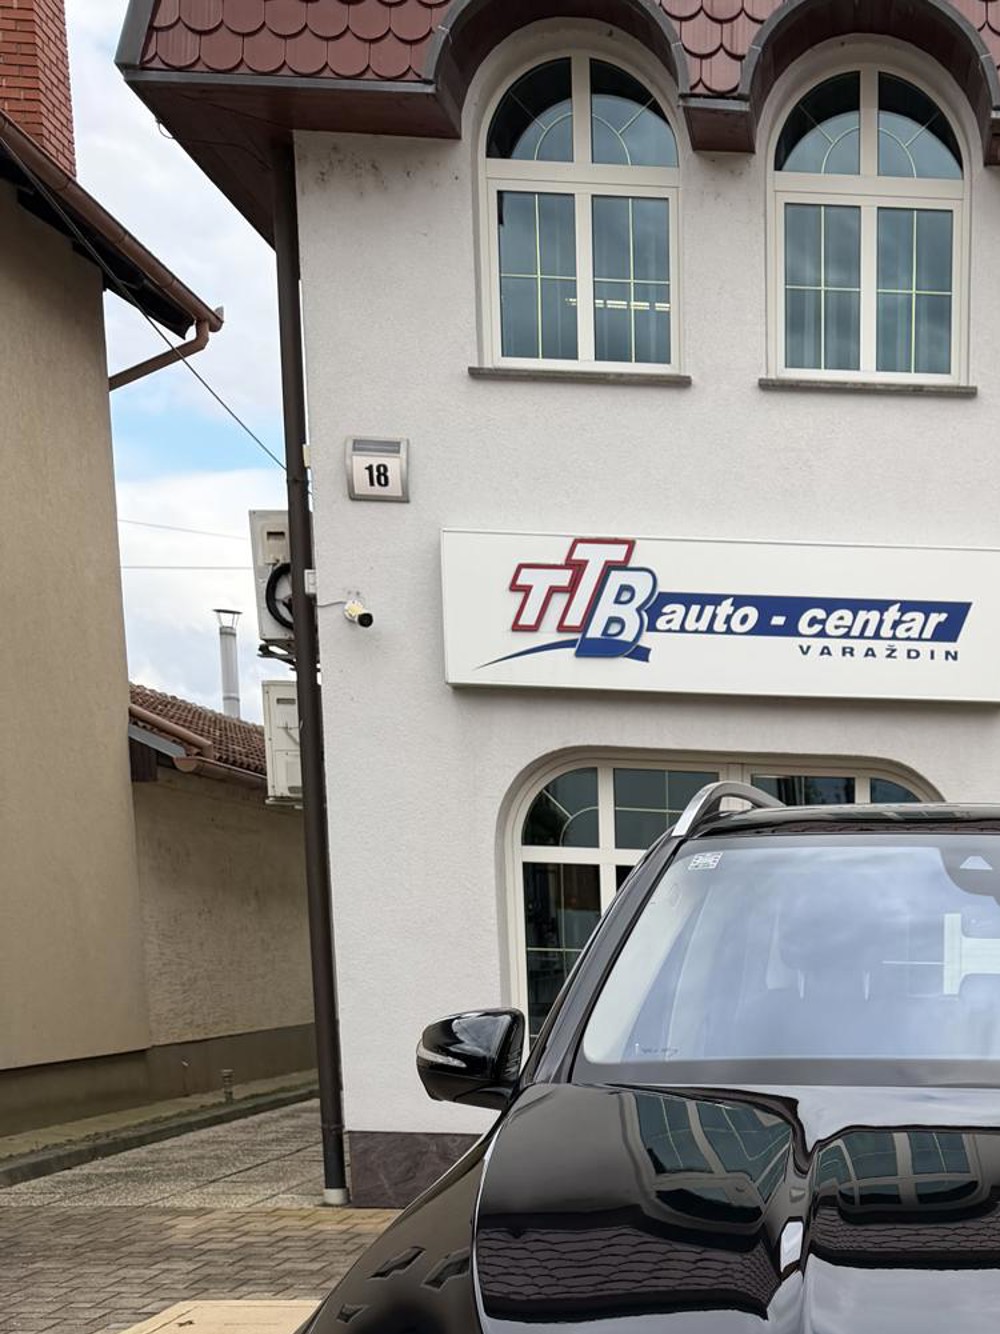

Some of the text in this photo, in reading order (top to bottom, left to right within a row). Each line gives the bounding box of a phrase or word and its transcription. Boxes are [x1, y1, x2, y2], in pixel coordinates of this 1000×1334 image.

[364, 463, 390, 488] 18
[509, 538, 658, 658] TTB
[655, 597, 759, 634] auto
[797, 602, 949, 640] centar
[798, 644, 960, 662] VARAŽDIN
